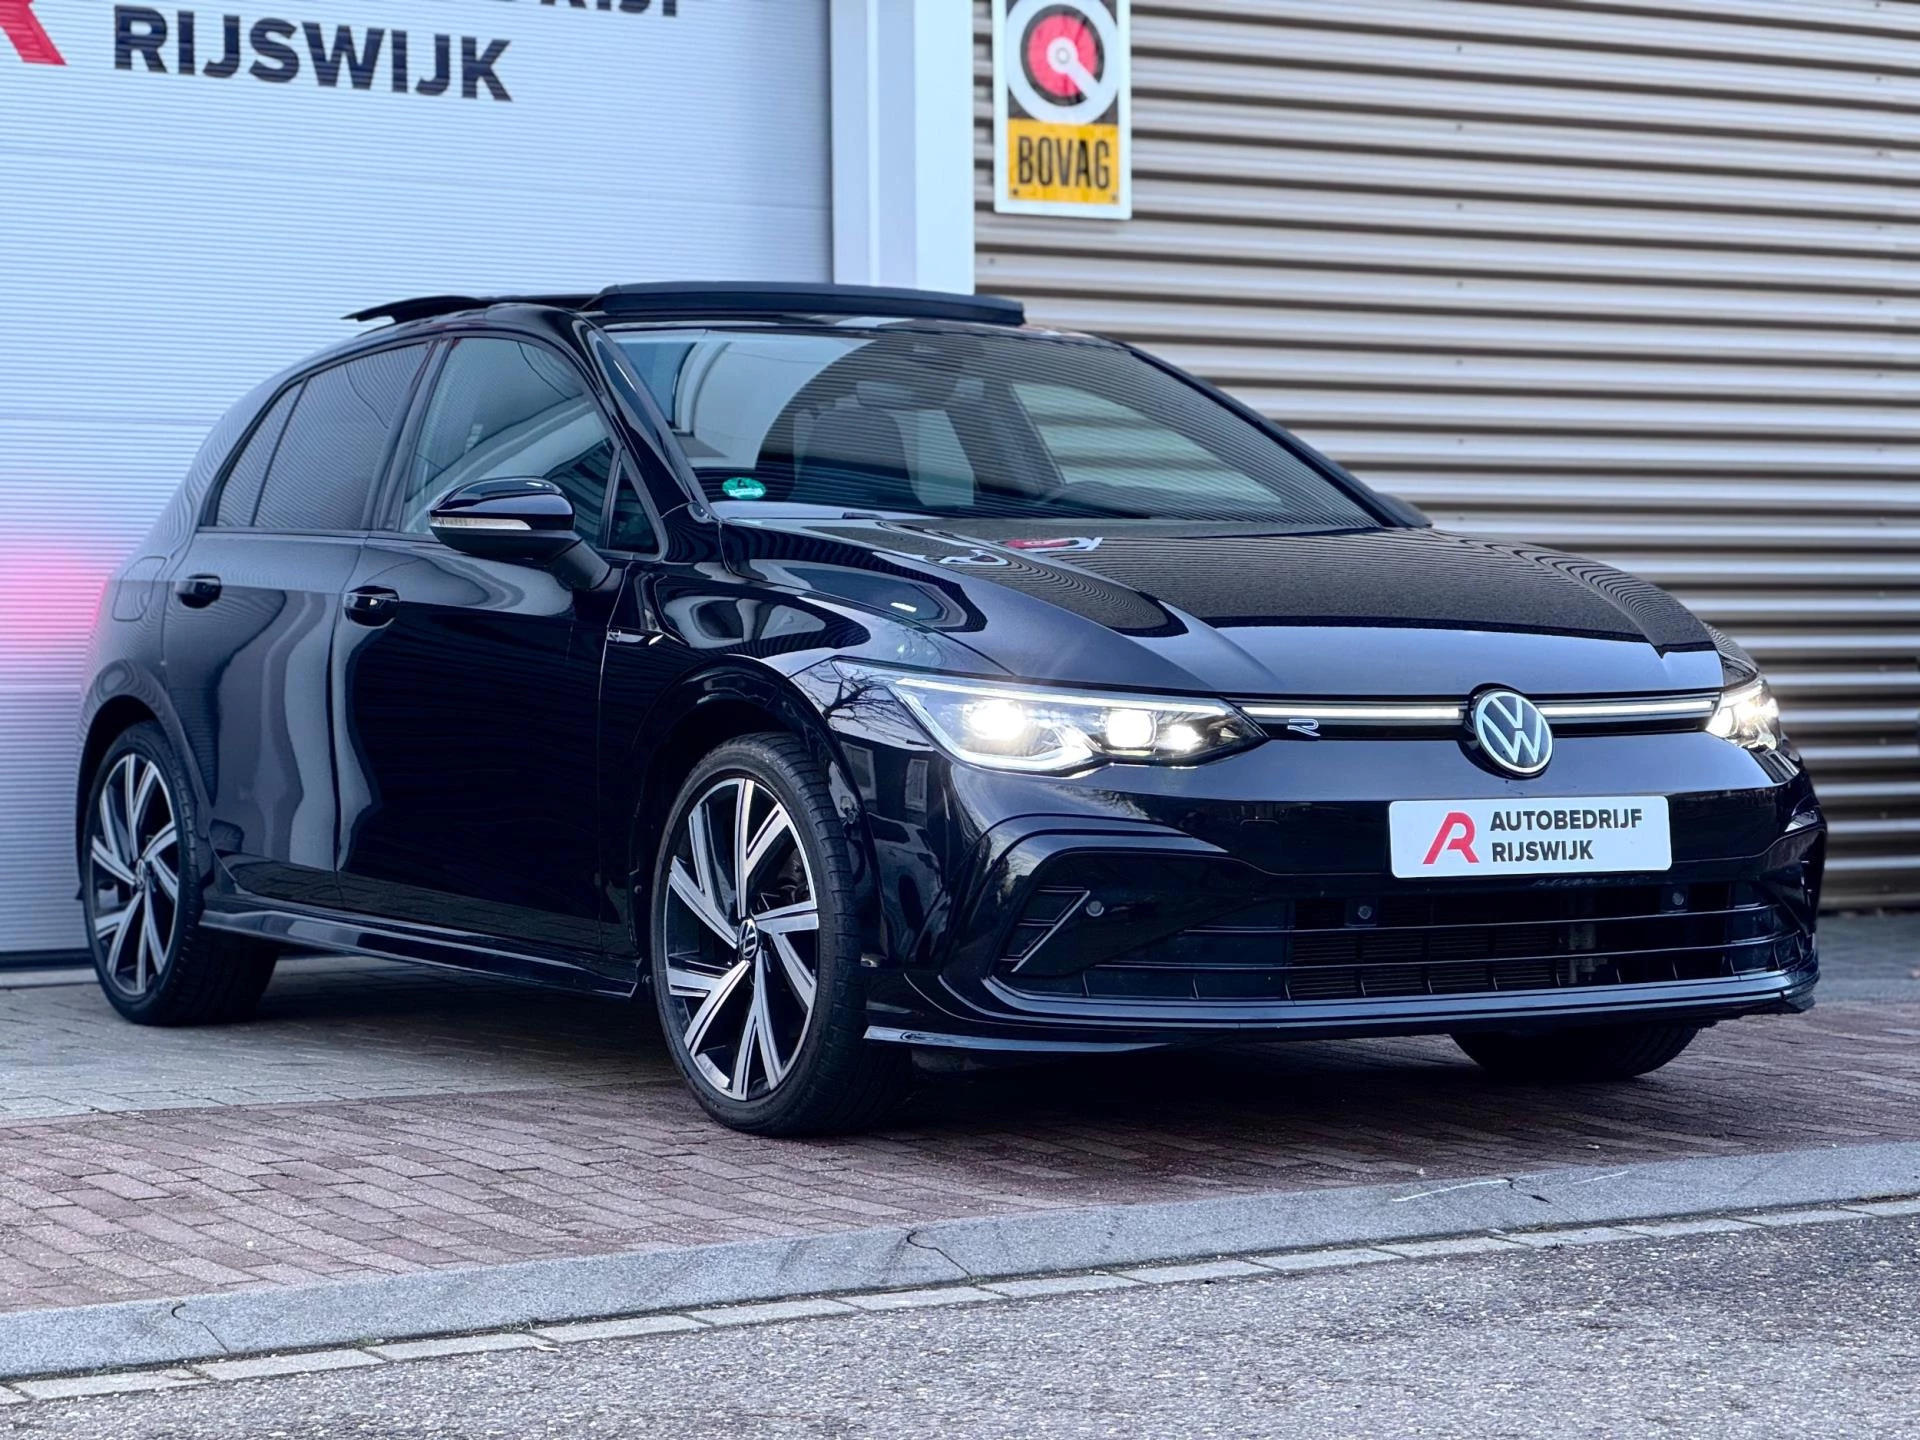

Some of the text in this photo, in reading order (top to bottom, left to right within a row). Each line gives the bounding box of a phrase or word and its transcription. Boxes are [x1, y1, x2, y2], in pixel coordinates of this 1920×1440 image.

[113, 5, 512, 101] RIJSWIJK
[1017, 136, 1111, 191] BOVAG
[1490, 808, 1642, 832] AUTOBEDRIJF
[1491, 840, 1593, 862] RIJSWIJK
